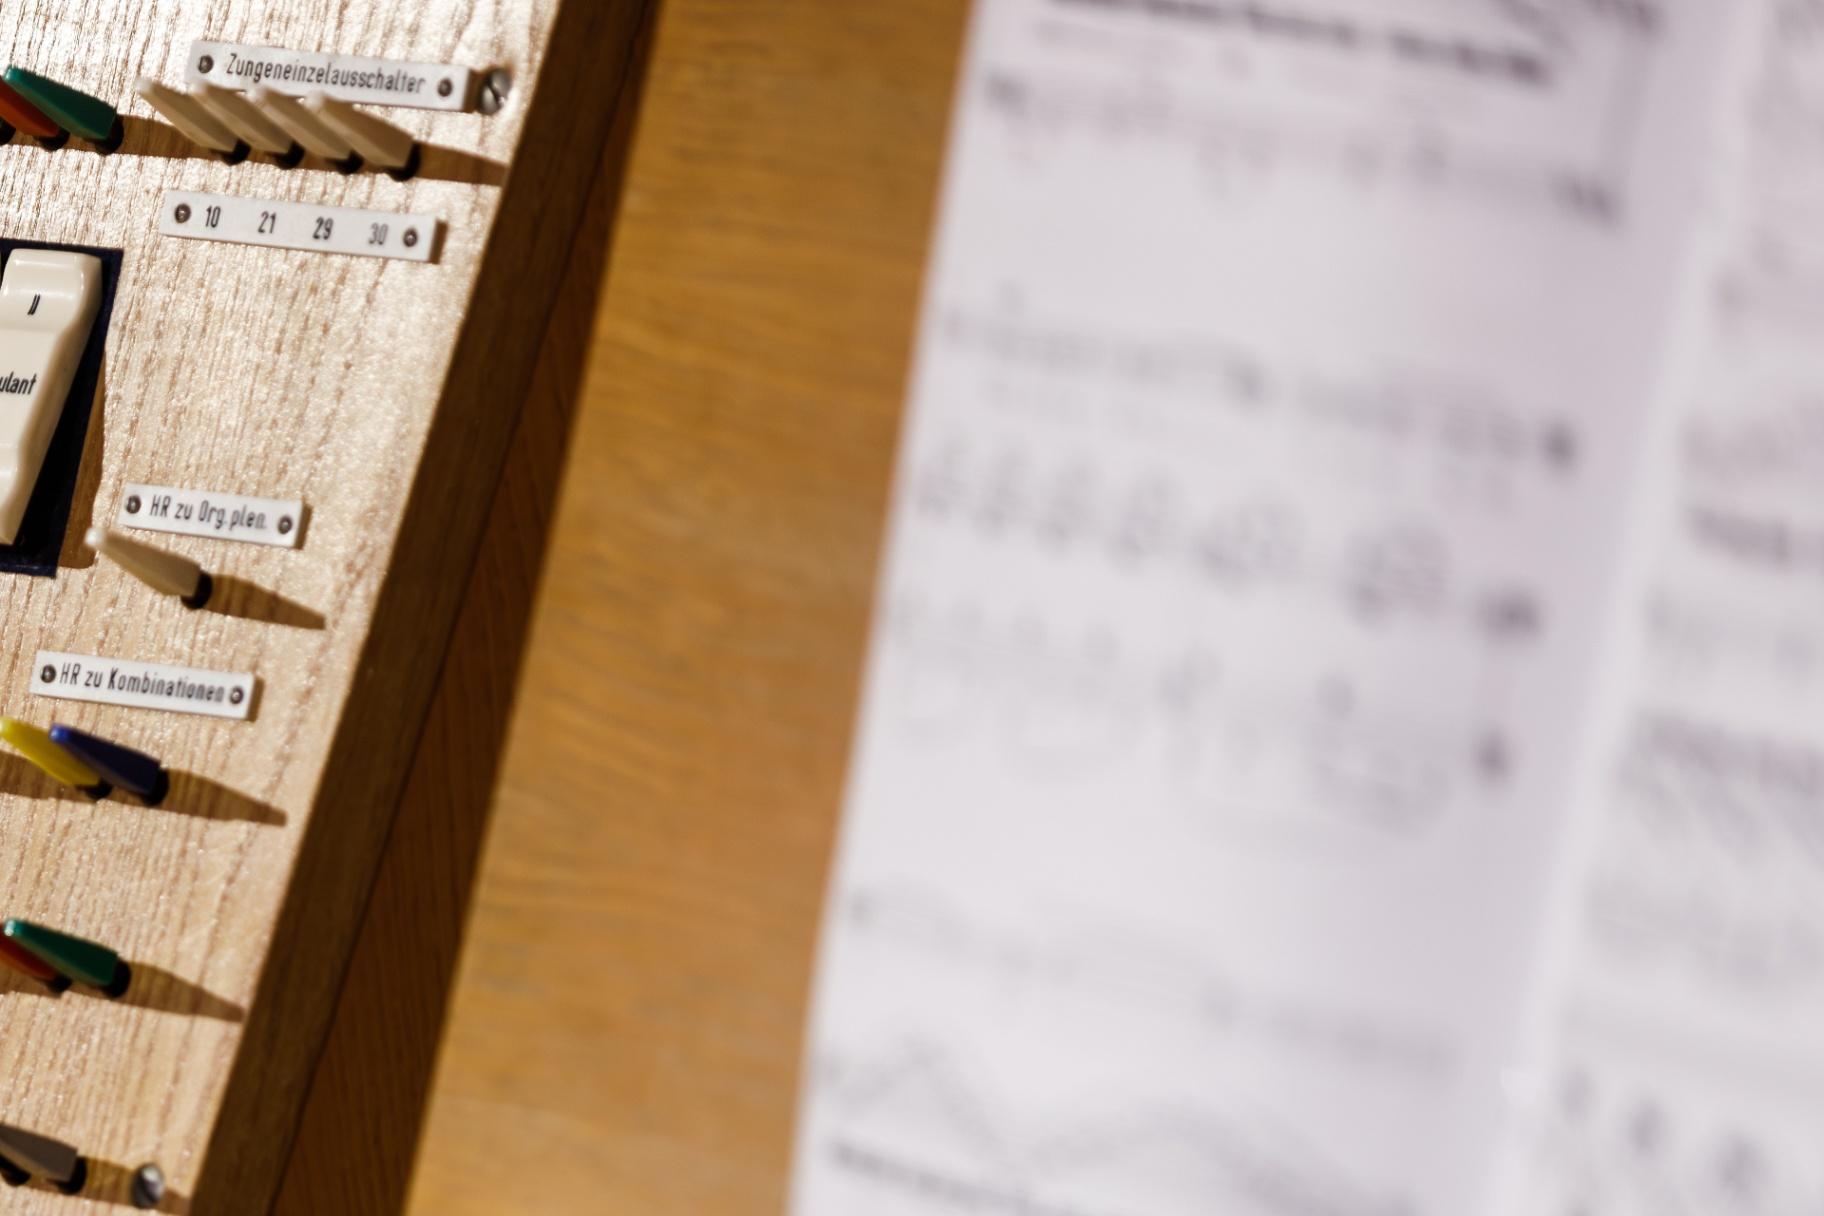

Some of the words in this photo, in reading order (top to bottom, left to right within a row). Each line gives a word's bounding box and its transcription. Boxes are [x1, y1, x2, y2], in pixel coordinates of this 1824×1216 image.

[225, 52, 427, 95] Zungeneinzelausschalter
[205, 205, 222, 228] 10
[257, 211, 276, 235] 21
[313, 217, 334, 241] 29
[368, 222, 389, 246] 30
[27, 294, 41, 316] II
[149, 494, 172, 519] HR
[175, 502, 193, 520] zu
[59, 662, 80, 686] HR
[84, 669, 102, 688] zu
[107, 667, 226, 703] Kombinationen
